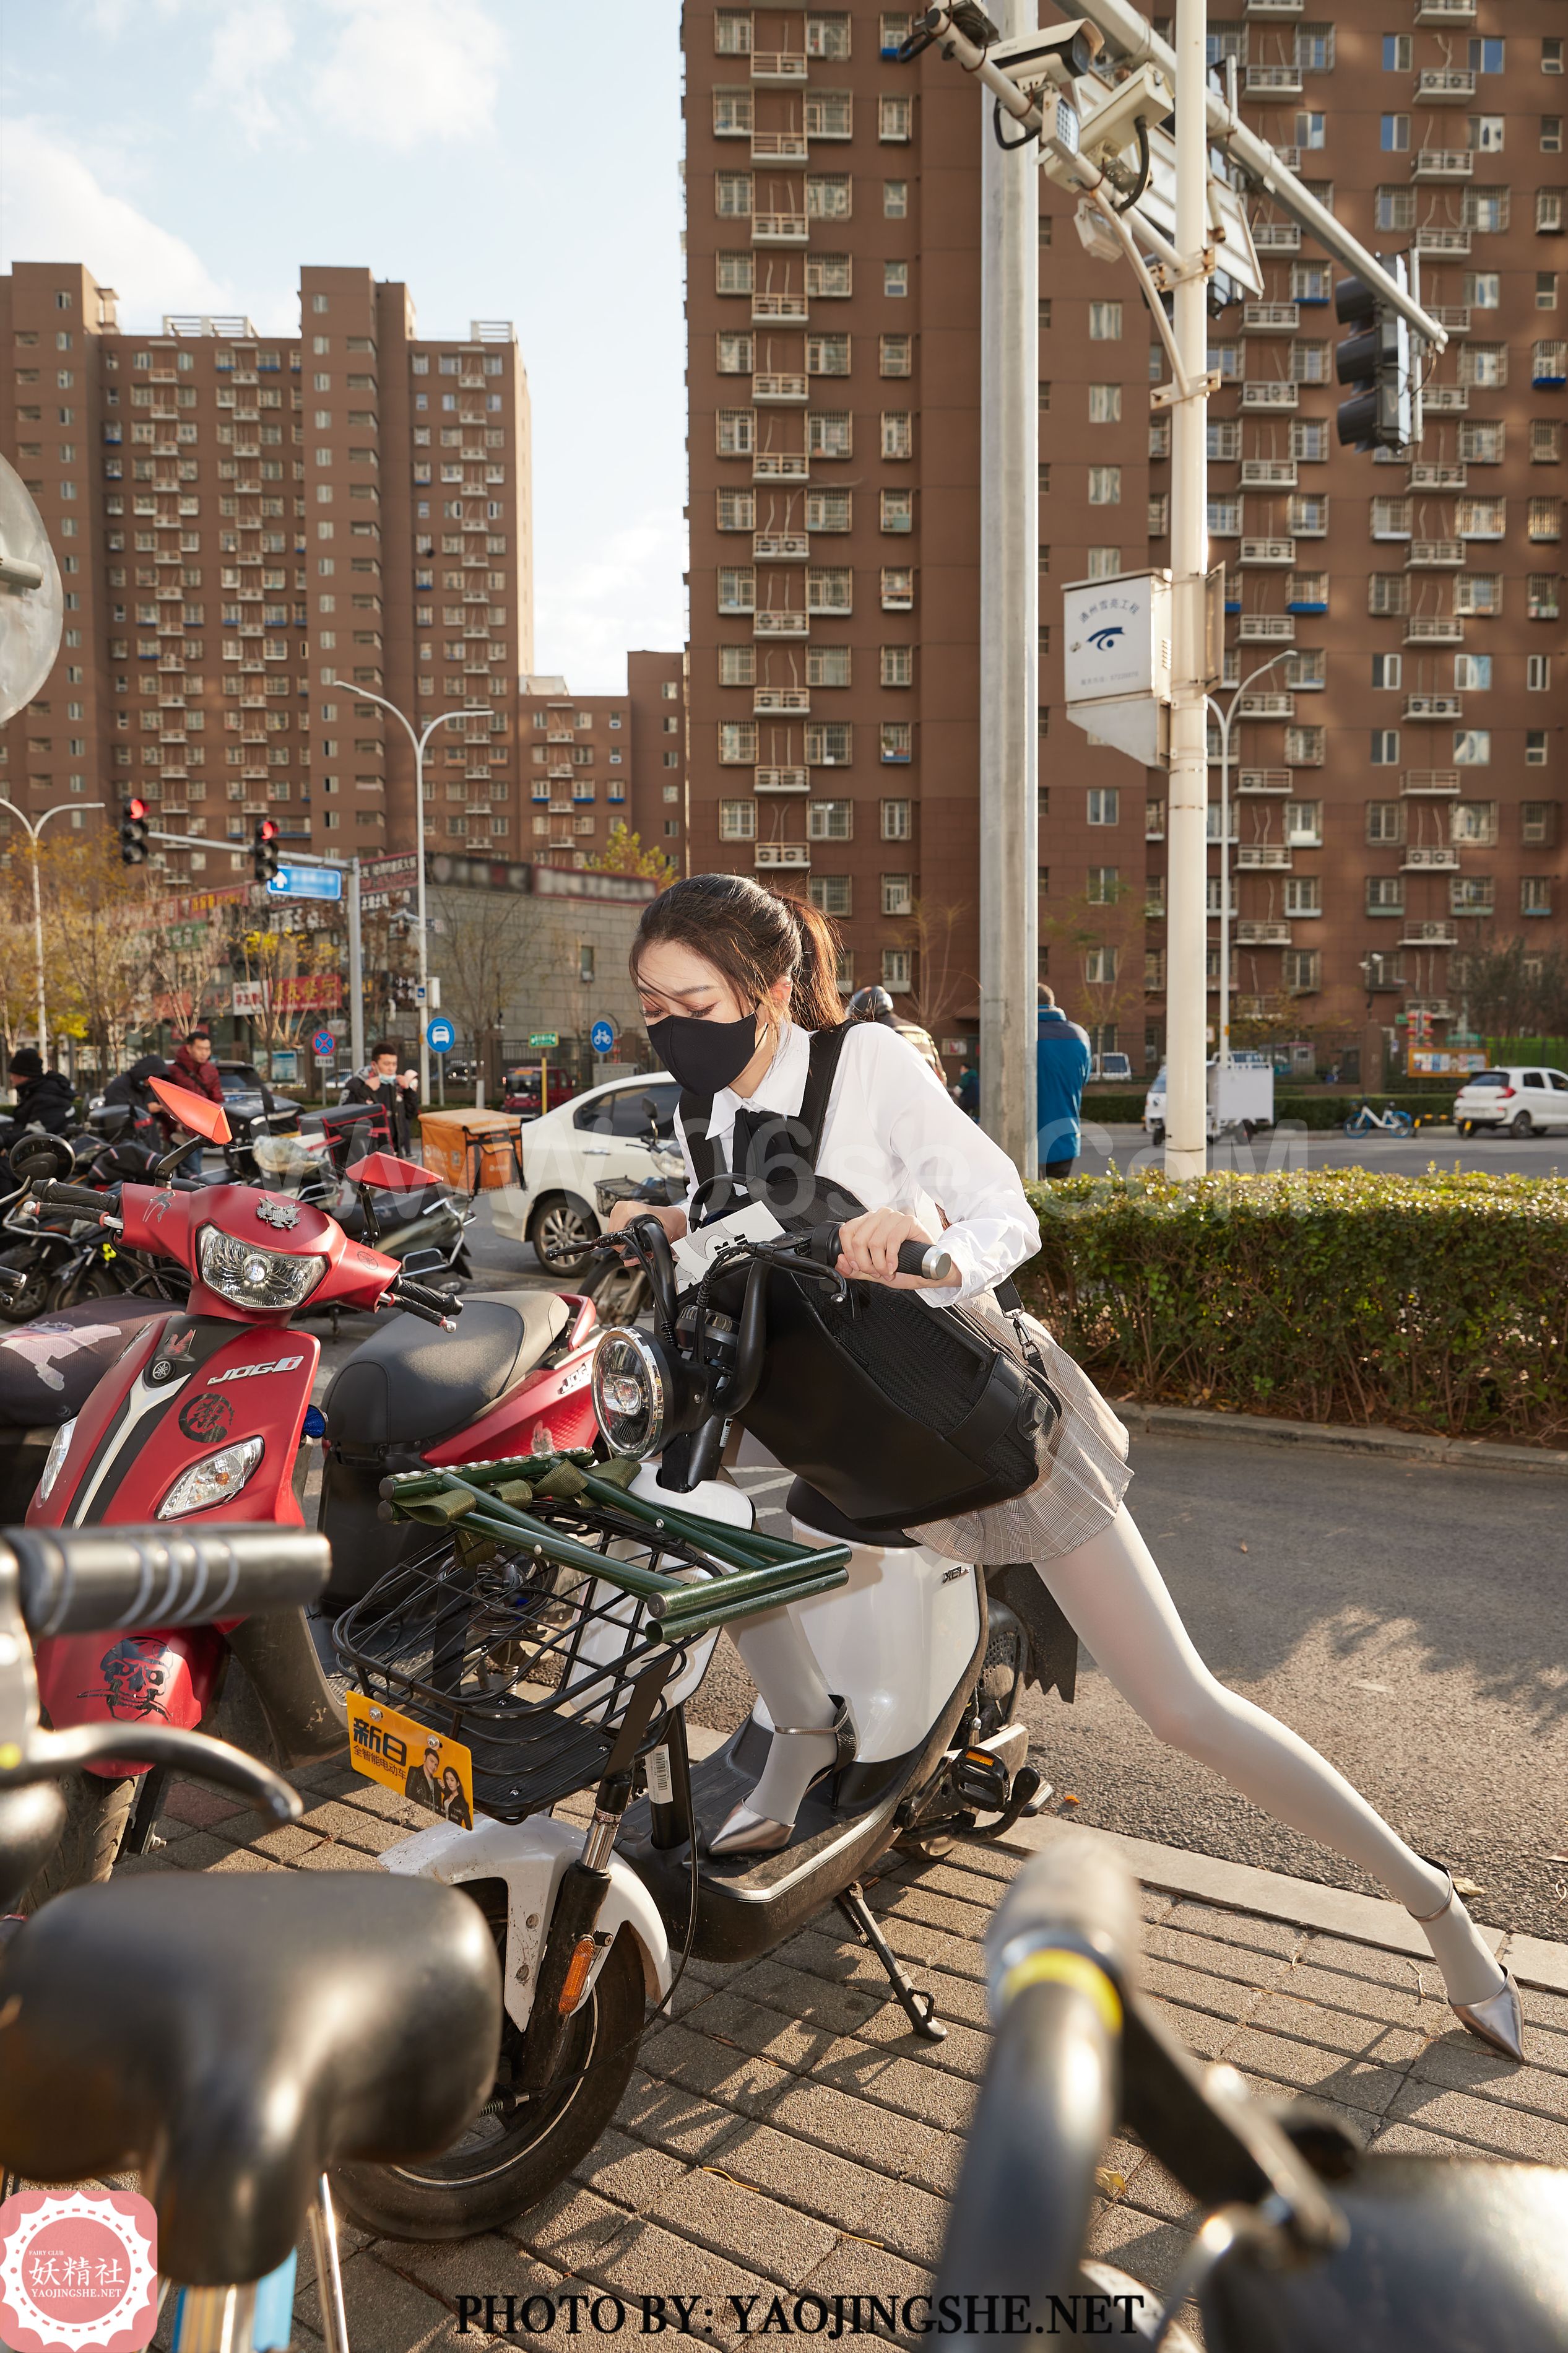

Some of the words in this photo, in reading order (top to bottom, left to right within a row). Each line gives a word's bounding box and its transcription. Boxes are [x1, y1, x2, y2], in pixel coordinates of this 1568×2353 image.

[353, 1717, 407, 1767] 新日
[353, 1745, 406, 1780] 全智能电动车
